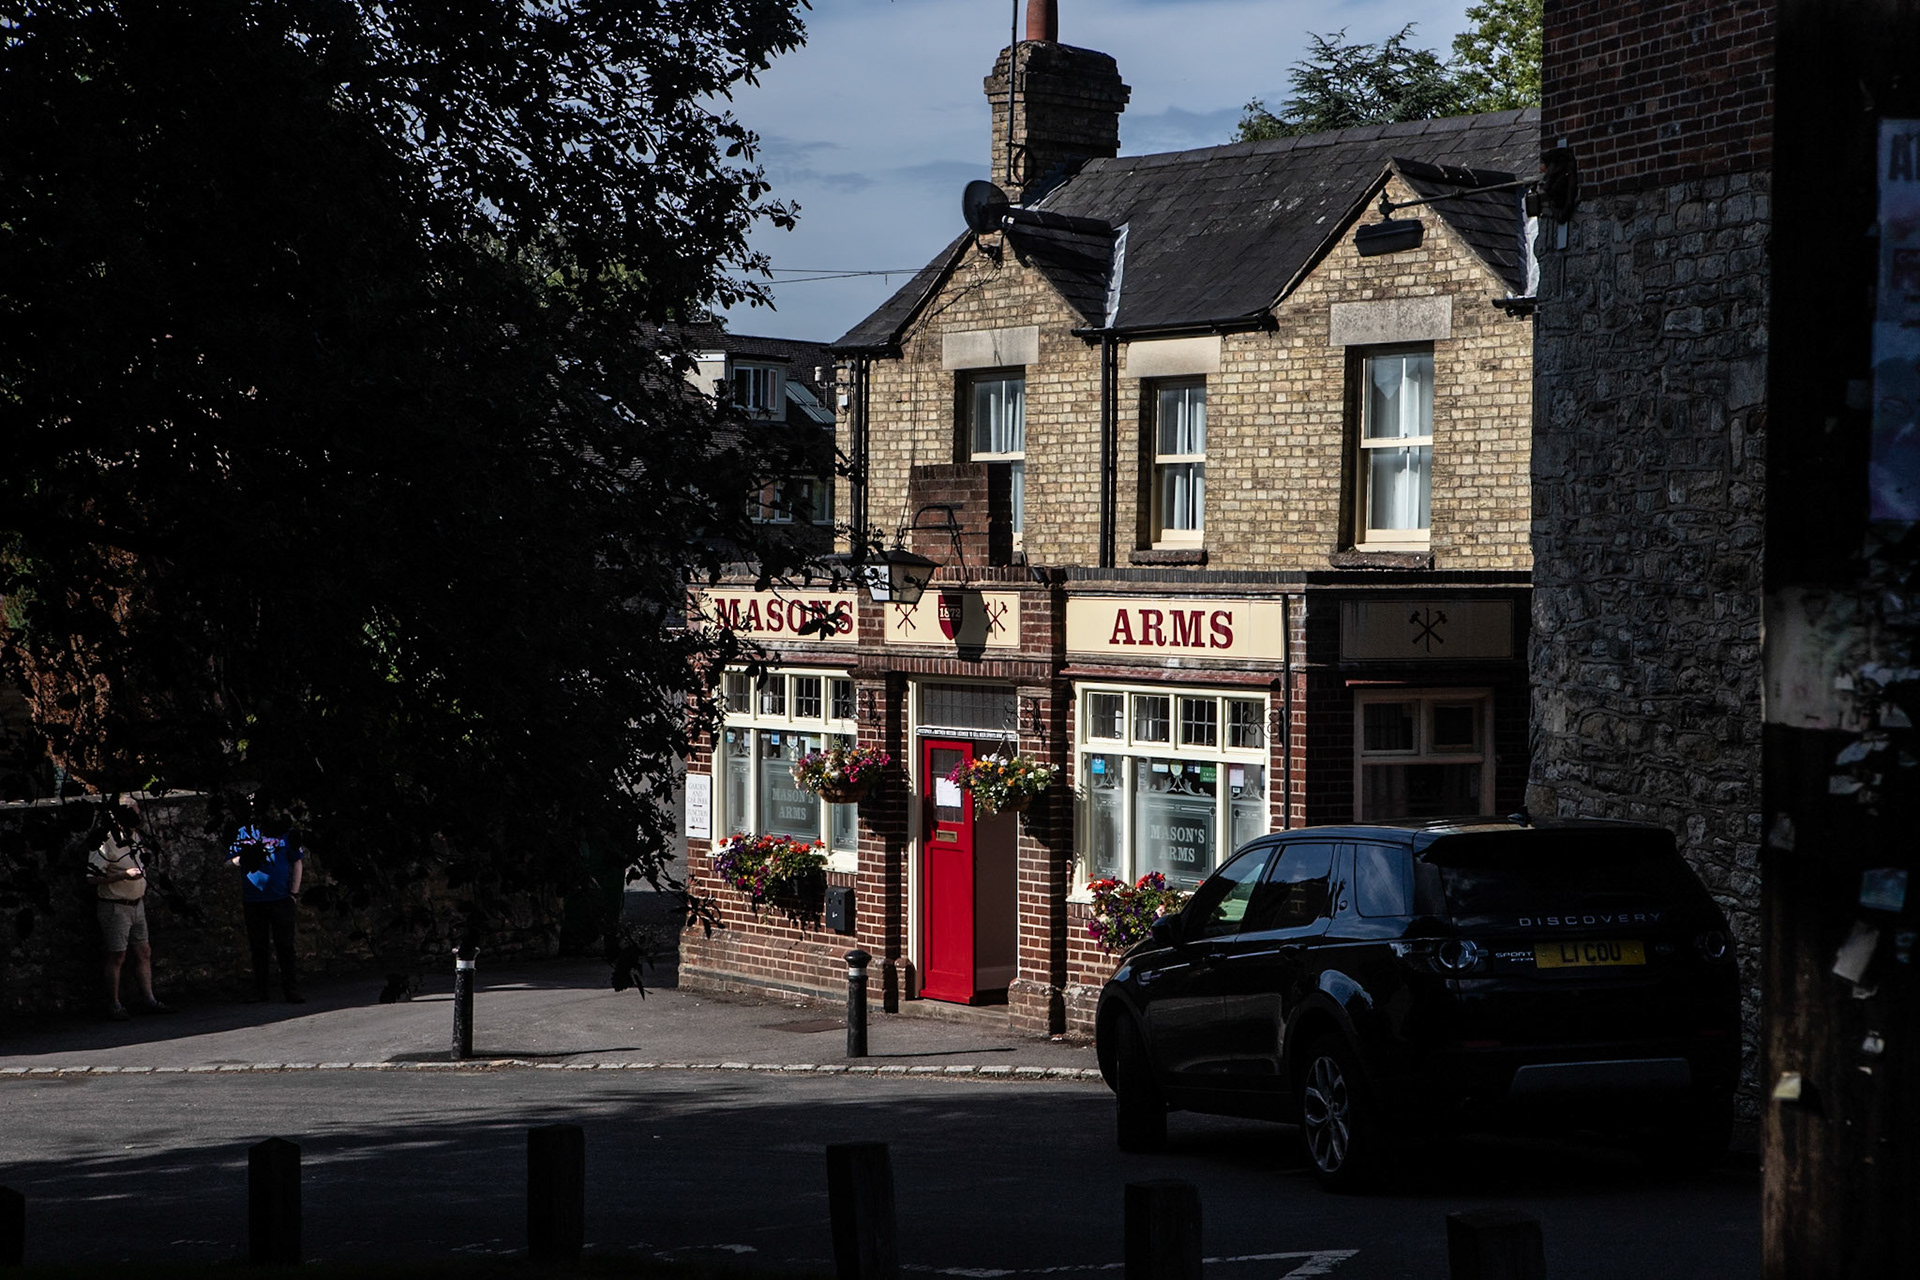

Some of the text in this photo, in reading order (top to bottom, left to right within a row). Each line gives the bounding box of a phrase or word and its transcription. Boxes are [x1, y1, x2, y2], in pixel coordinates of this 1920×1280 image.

[940, 607, 961, 618] 1872
[1109, 608, 1234, 650] ARMS
[772, 788, 814, 804] MASONS
[779, 805, 807, 820] ARMS
[1150, 824, 1205, 844] MASON'S
[1159, 845, 1195, 863] ARMS
[1518, 913, 1661, 927] DISCOVERY
